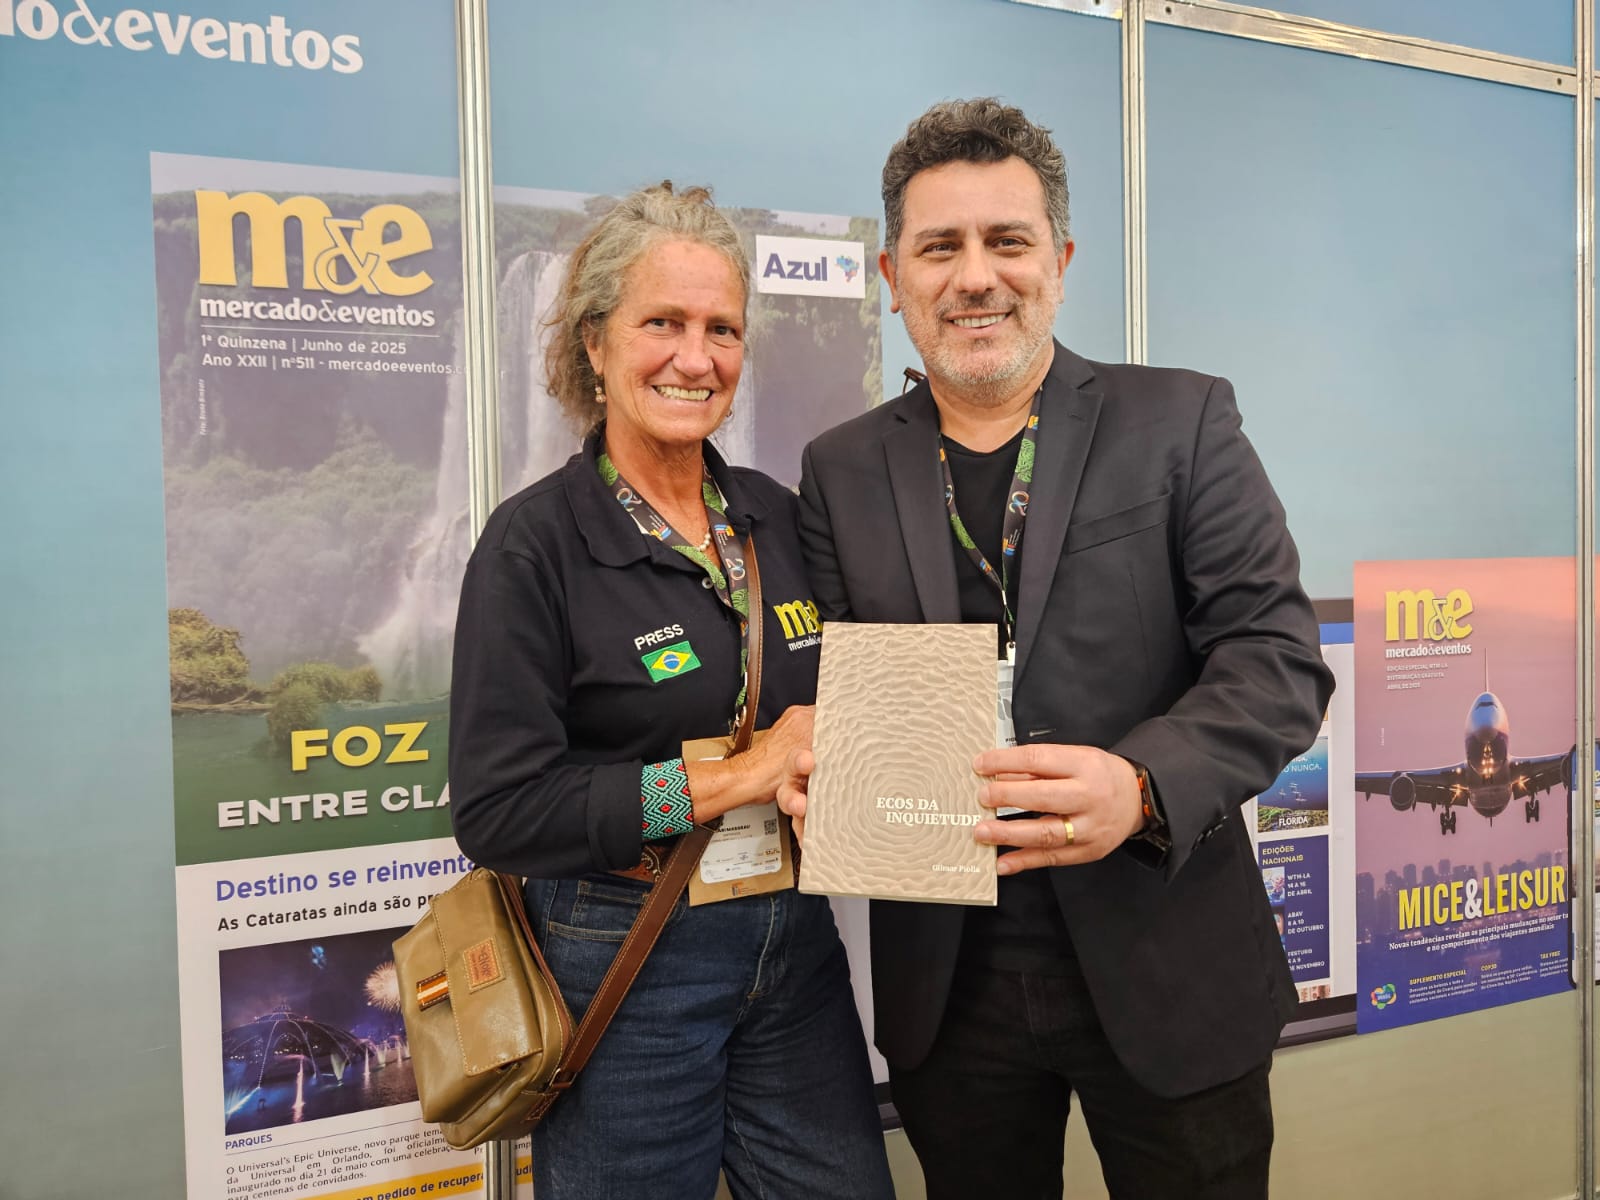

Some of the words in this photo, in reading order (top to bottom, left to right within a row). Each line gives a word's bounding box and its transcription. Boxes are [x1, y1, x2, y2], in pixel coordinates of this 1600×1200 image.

[195, 190, 434, 296] m&e
[763, 253, 828, 281] Azul
[200, 298, 435, 327] mercado&eventos
[217, 335, 287, 351] Quinzena
[301, 338, 343, 353] Junho
[348, 340, 365, 353] de
[371, 341, 407, 355] 2025
[202, 353, 232, 366] Ano
[237, 354, 267, 368] XXII
[1384, 588, 1474, 641] m&e
[633, 623, 684, 651] PRESS
[1385, 642, 1472, 658] mercado&eventos
[291, 722, 429, 771] FOZ
[217, 789, 369, 828] ENTRE
[876, 797, 914, 810] ECOS
[917, 798, 939, 810] DA
[1278, 816, 1309, 826] FLORIDA
[1262, 845, 1294, 856] EDIÇÕES
[1262, 854, 1304, 866] NACIONAIS
[216, 873, 318, 902] Destino
[328, 869, 357, 888] se
[1398, 866, 1568, 930] MICE&LEISUR
[217, 917, 239, 932] As
[246, 907, 327, 928] Cataratas
[333, 900, 377, 917] ainda
[384, 895, 411, 911] são
[1296, 924, 1324, 933] OUTUBRO
[1389, 942, 1410, 951] Novas
[1410, 934, 1444, 947] tendências
[1445, 930, 1471, 941] revelam
[1478, 922, 1509, 936] principais
[1440, 934, 1488, 949] comportamento
[1500, 928, 1528, 939] viajantes
[1410, 974, 1443, 986] SUPLEMENTO
[1444, 970, 1466, 979] ESPECIAL
[225, 1134, 273, 1151] PARQUES
[226, 1167, 234, 1176] O
[238, 1156, 291, 1174] Universal's
[294, 1154, 314, 1165] Epic
[364, 1139, 387, 1150] novo
[390, 1132, 420, 1147] parque
[226, 1177, 239, 1185] da
[251, 1166, 296, 1180] Universal
[306, 1162, 321, 1170] em
[332, 1152, 372, 1165] Orlando,
[384, 1146, 396, 1154] foi
[228, 1178, 281, 1194] inaugurado
[300, 1171, 314, 1180] dia
[316, 1168, 328, 1178] 21
[330, 1166, 342, 1175] de
[345, 1162, 368, 1172] maio
[370, 1158, 390, 1168] com
[392, 1153, 412, 1162] uma
[252, 1186, 294, 1200] centenas
[297, 1182, 309, 1191] de
[312, 1172, 367, 1188] convidados.
[377, 1186, 416, 1200] pedido
[420, 1183, 434, 1194] de
